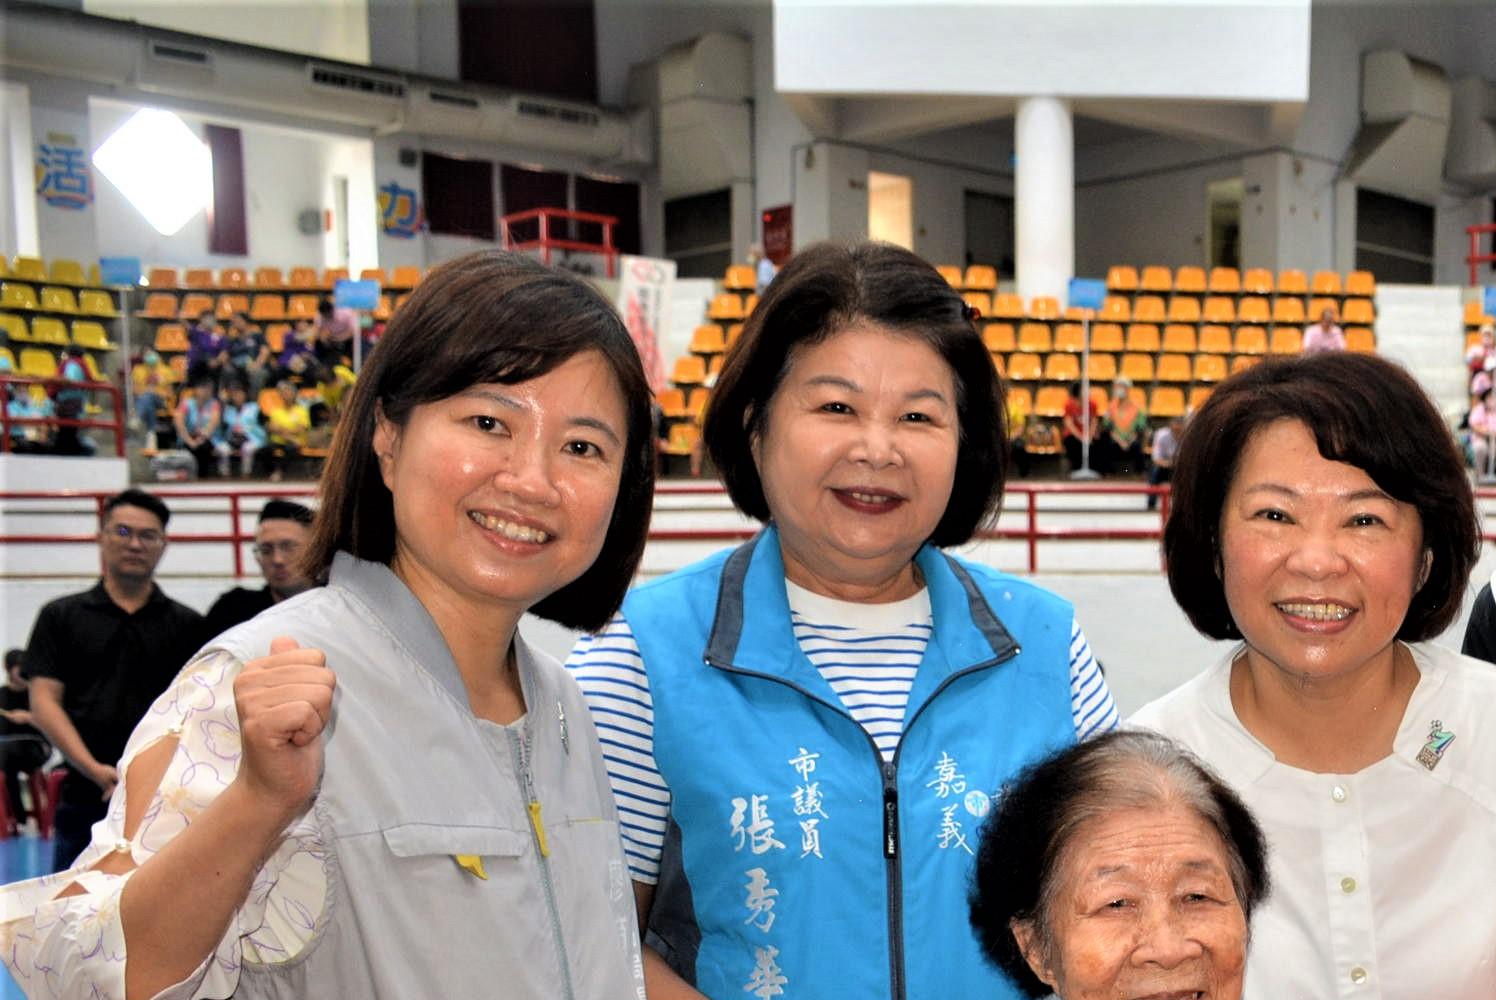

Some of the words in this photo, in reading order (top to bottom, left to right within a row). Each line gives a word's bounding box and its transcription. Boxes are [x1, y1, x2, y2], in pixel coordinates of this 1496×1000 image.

[37, 144, 89, 195] 活
[379, 182, 417, 226] 力
[787, 747, 829, 860] 市議員
[926, 752, 975, 856] 嘉義
